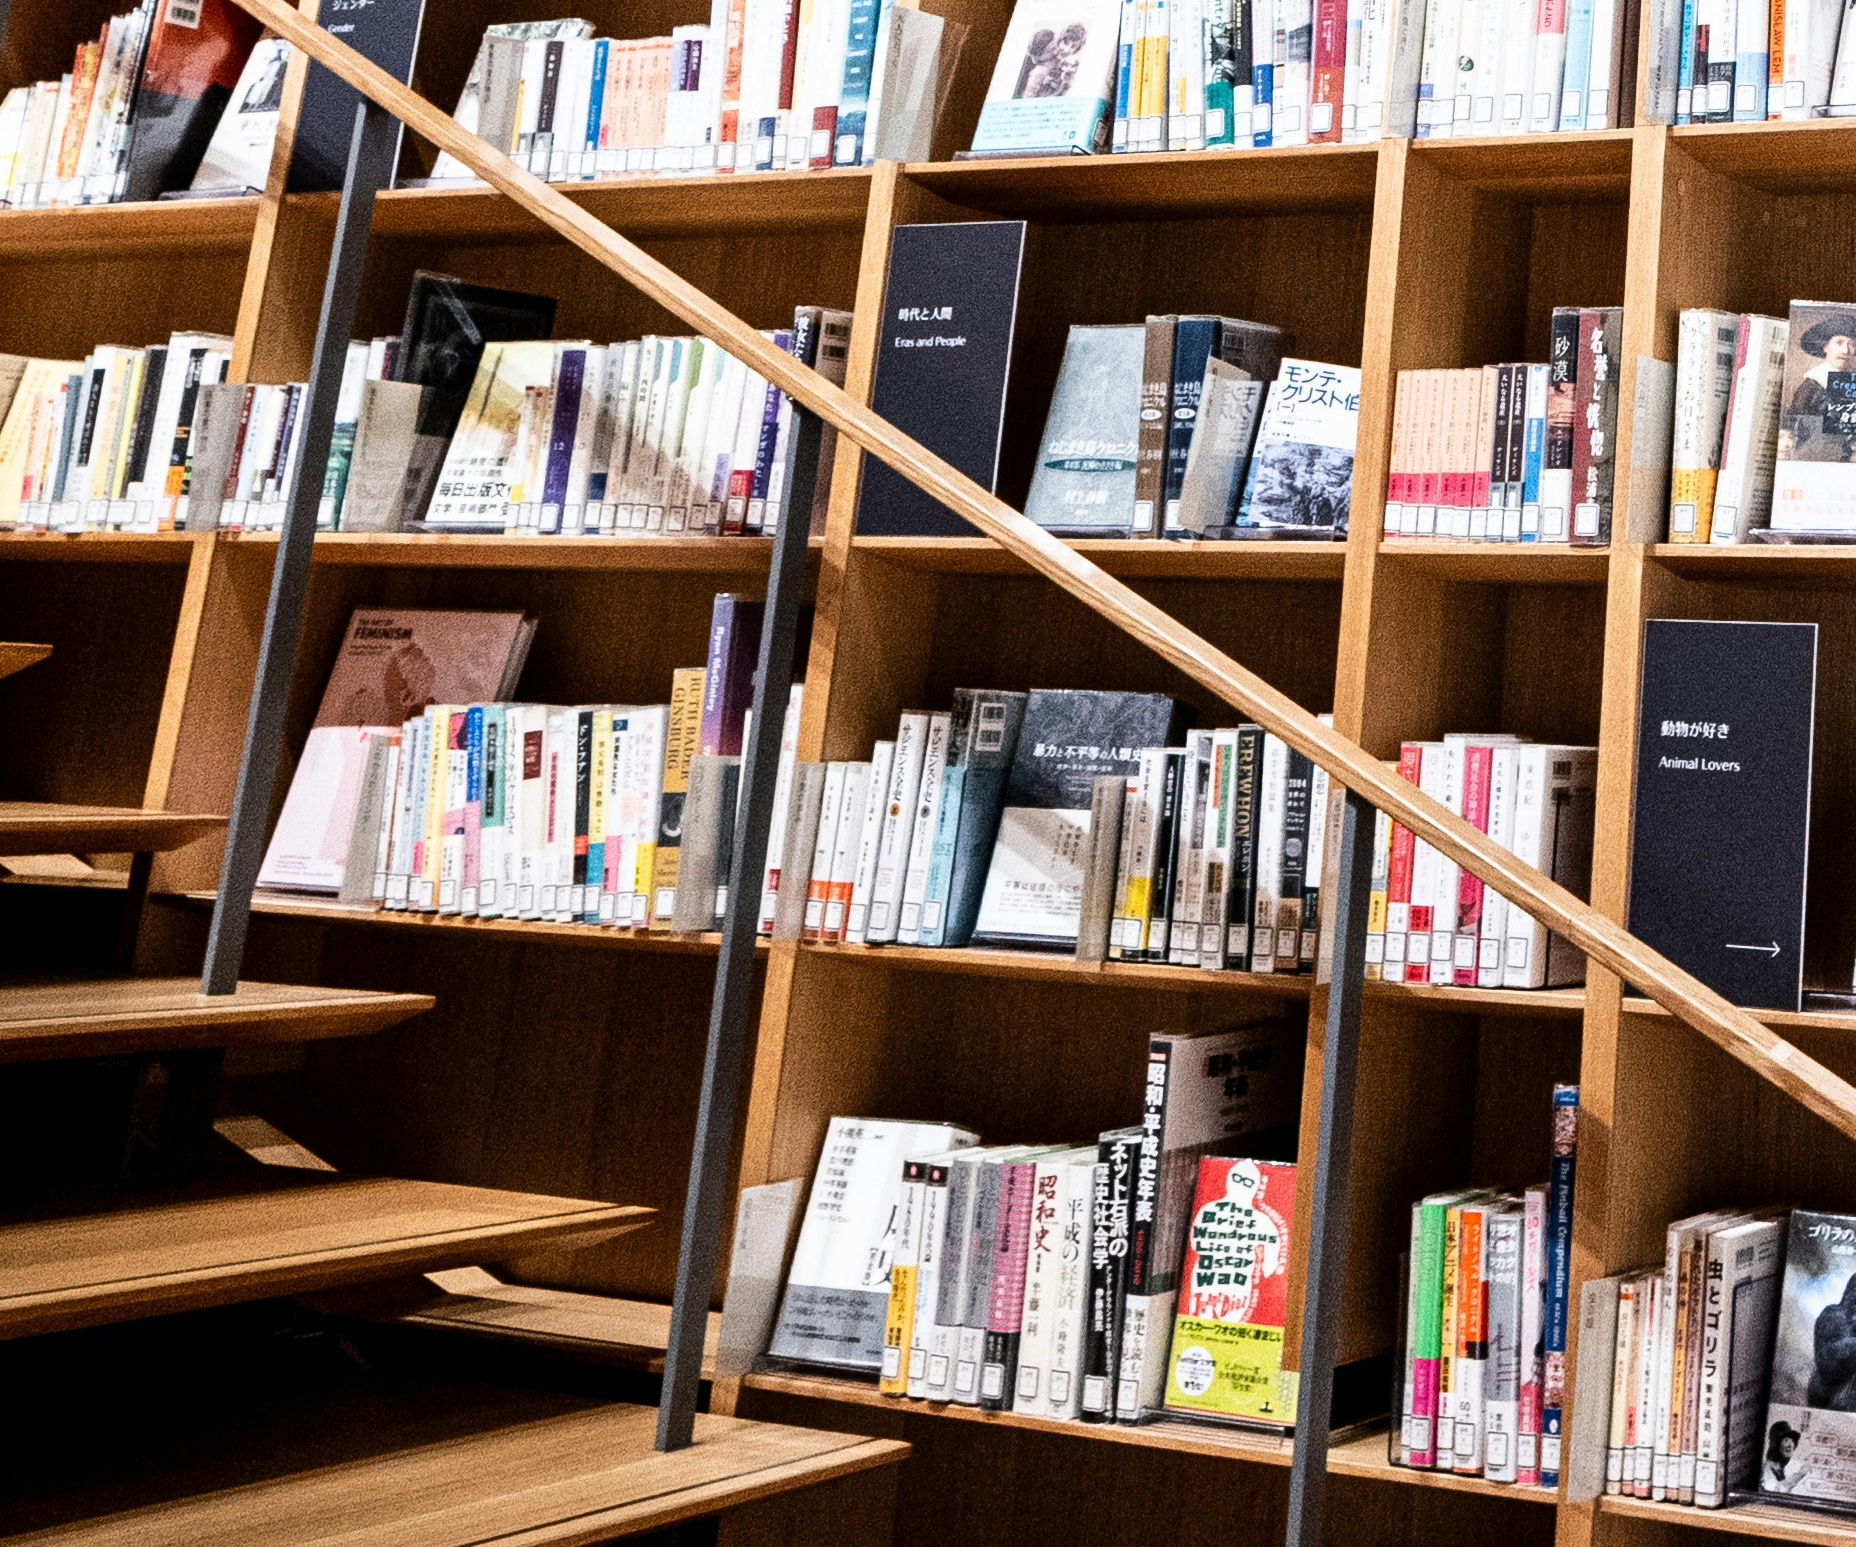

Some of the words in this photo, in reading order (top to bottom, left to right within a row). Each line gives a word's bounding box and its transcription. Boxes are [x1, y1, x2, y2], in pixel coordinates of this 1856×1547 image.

[328, 22, 355, 33] Gender
[898, 306, 953, 322] 時代と人間
[894, 337, 914, 348] Eras
[915, 337, 934, 347] and
[935, 336, 967, 348] People
[1552, 335, 1571, 383] 砂漠
[1585, 327, 1609, 457] 名誉と恍惚
[1683, 326, 1697, 451] クララとお日さま
[690, 676, 702, 718] RUTH
[666, 687, 685, 771] GINSBURG
[1660, 720, 1730, 740] 動物が好き
[892, 722, 912, 802] サピエンス全史
[922, 723, 943, 804] サピエンス全史
[1032, 742, 1142, 764] 暴力と不平等の人類史
[1658, 756, 1699, 770] Animal
[1701, 758, 1741, 772] Lovers
[1135, 1061, 1168, 1223] 昭和・平成史年表
[1033, 1173, 1059, 1254] 昭和史
[1092, 1164, 1111, 1270] 歴史社会学
[1109, 1140, 1130, 1258] ネット右派の
[1201, 1209, 1258, 1230] Brief
[1215, 1200, 1254, 1219] The
[1061, 1197, 1086, 1263] 平成の
[1193, 1225, 1279, 1245] Wondrous
[1195, 1240, 1232, 1255] Life
[1237, 1243, 1254, 1256] of
[1196, 1271, 1249, 1288] Wao
[1198, 1254, 1254, 1272] Oscar
[1704, 1259, 1724, 1378] 虫とゴリラ
